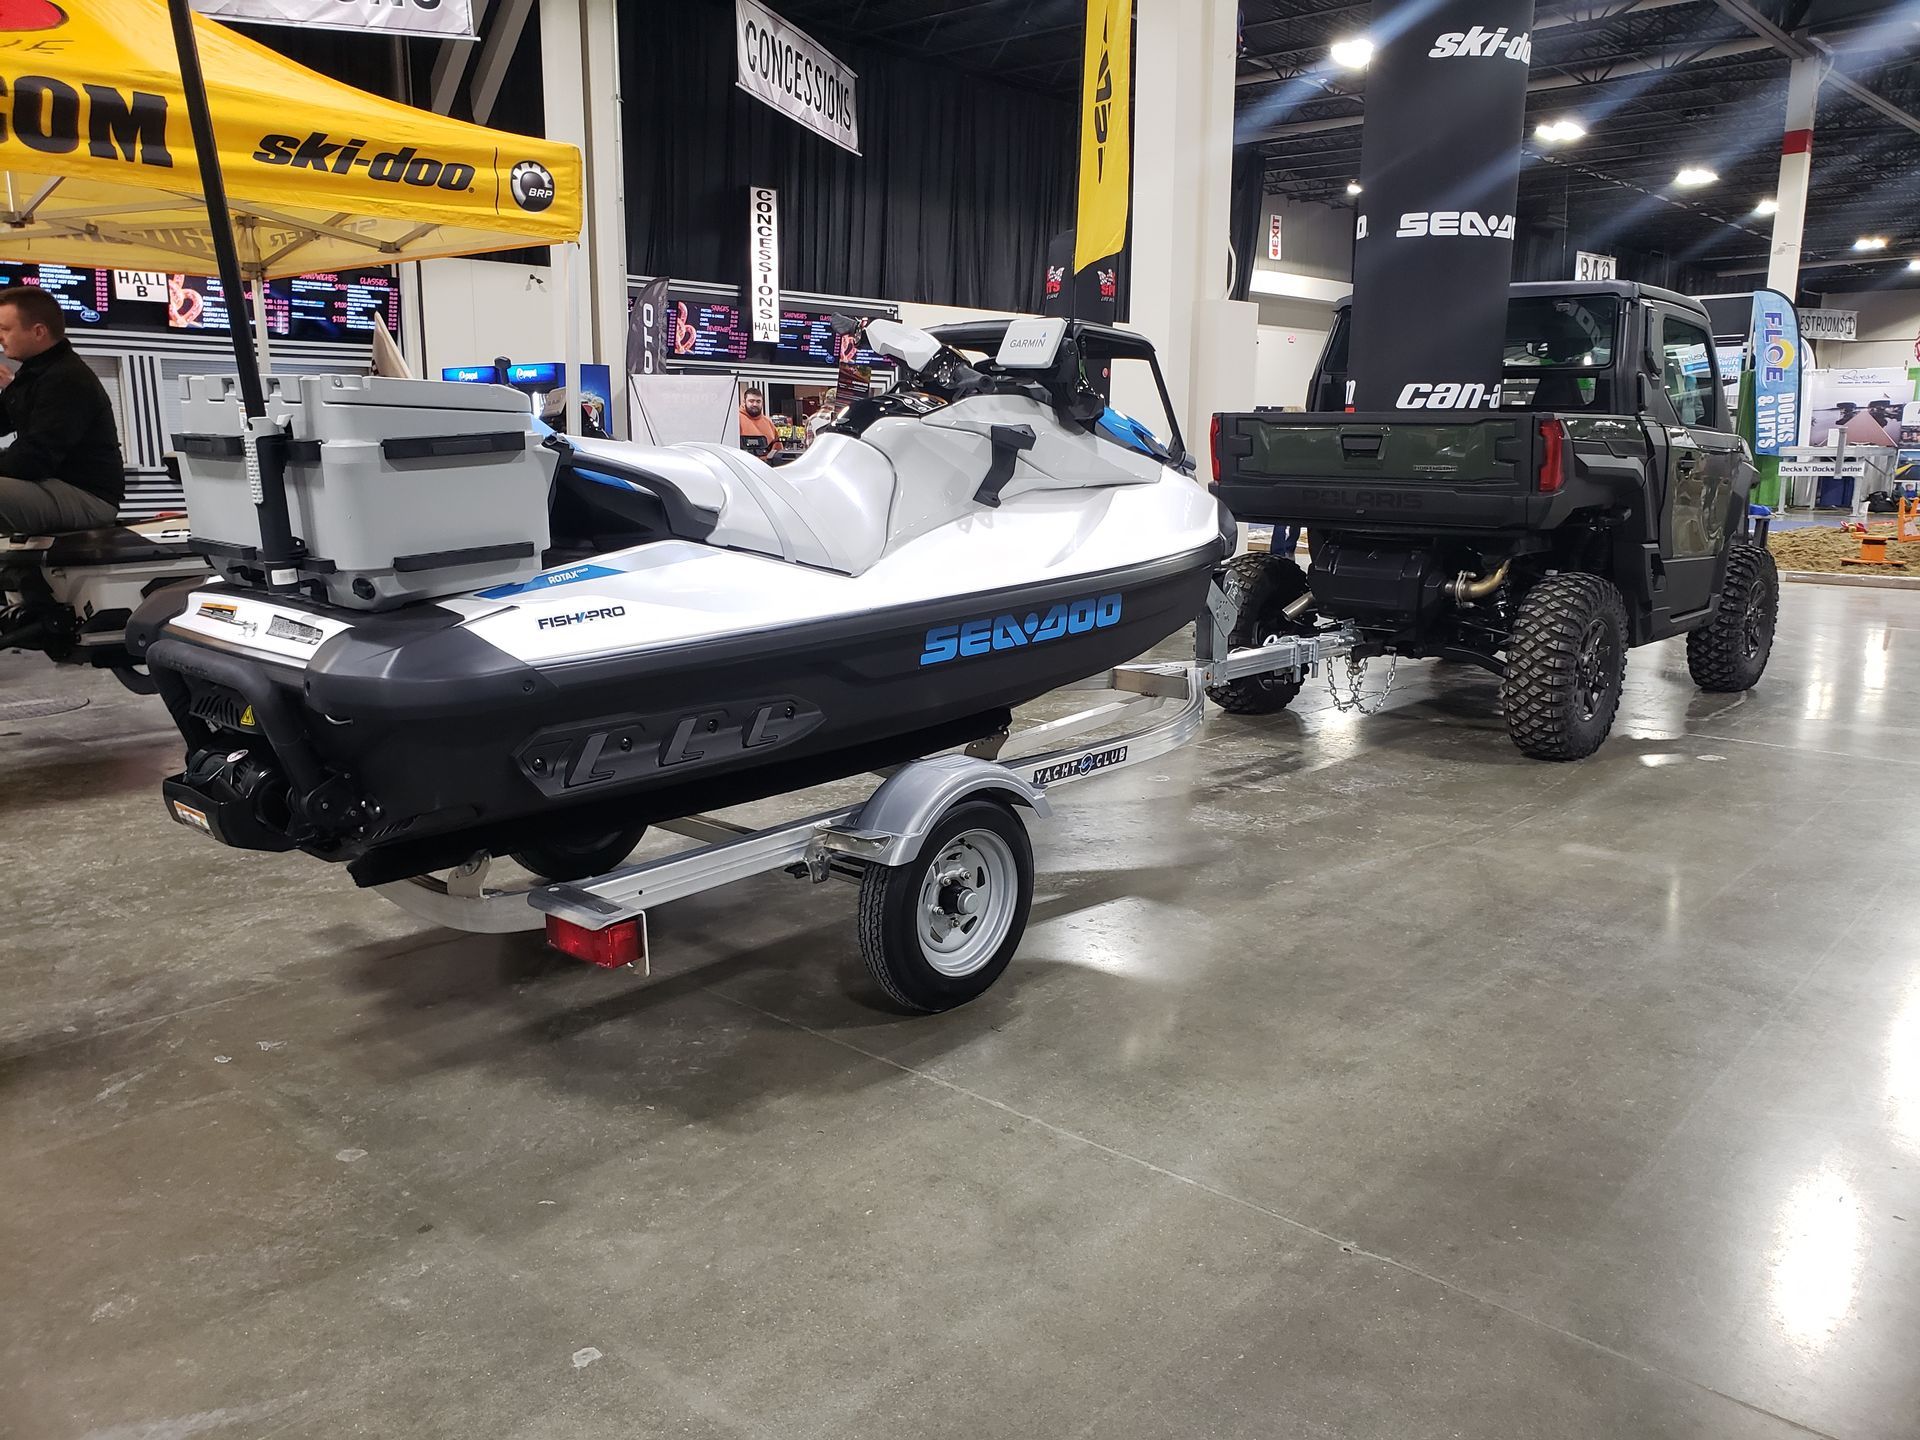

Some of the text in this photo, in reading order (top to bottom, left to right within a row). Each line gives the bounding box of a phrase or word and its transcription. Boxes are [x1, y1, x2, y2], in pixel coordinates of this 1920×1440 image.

[746, 19, 852, 132] CONCESSIONS
[0, 74, 174, 168] OM
[252, 131, 476, 191] ski-doo
[528, 186, 554, 199] BRP
[1272, 215, 1280, 248] EXIT
[756, 189, 774, 320] CONCESSIONS
[118, 271, 165, 286] HALL
[136, 286, 149, 298] B
[754, 322, 779, 332] HALL
[1800, 315, 1845, 333] ESTROOMS
[762, 331, 770, 340] A
[1009, 338, 1047, 348] GARMIN
[1764, 312, 1784, 383] FLOE
[1757, 395, 1777, 449] & LIFTS
[1777, 391, 1796, 443] DOCKS
[1780, 465, 1802, 473] Decks
[1812, 465, 1835, 473] Docks
[1842, 465, 1862, 473] arine
[1301, 489, 1424, 510] POLARIS
[547, 570, 580, 585] ROTAX
[1036, 747, 1127, 784] YACHT CLUB
